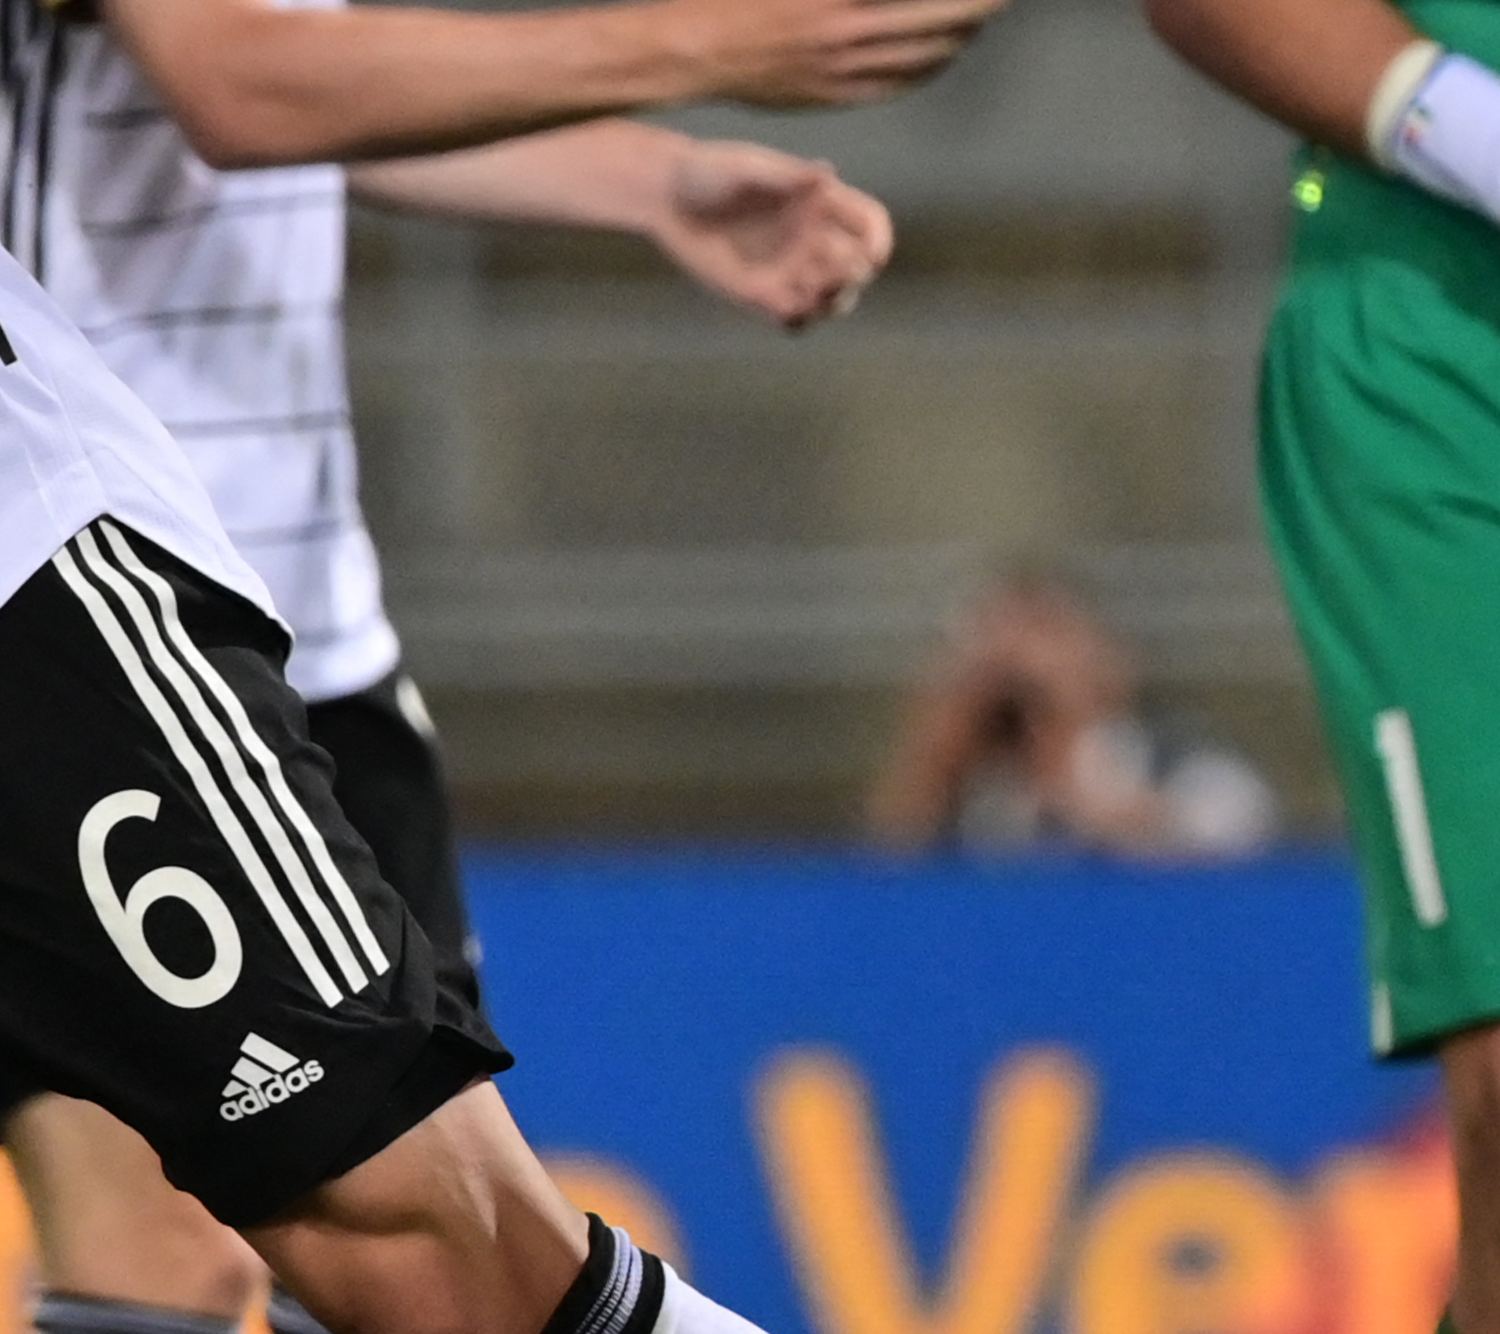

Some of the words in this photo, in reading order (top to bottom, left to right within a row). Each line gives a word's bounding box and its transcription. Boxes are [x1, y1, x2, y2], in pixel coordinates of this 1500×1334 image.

[77, 788, 243, 1009] 6
[1374, 706, 1447, 929] 1
[218, 1058, 325, 1122] adidas
